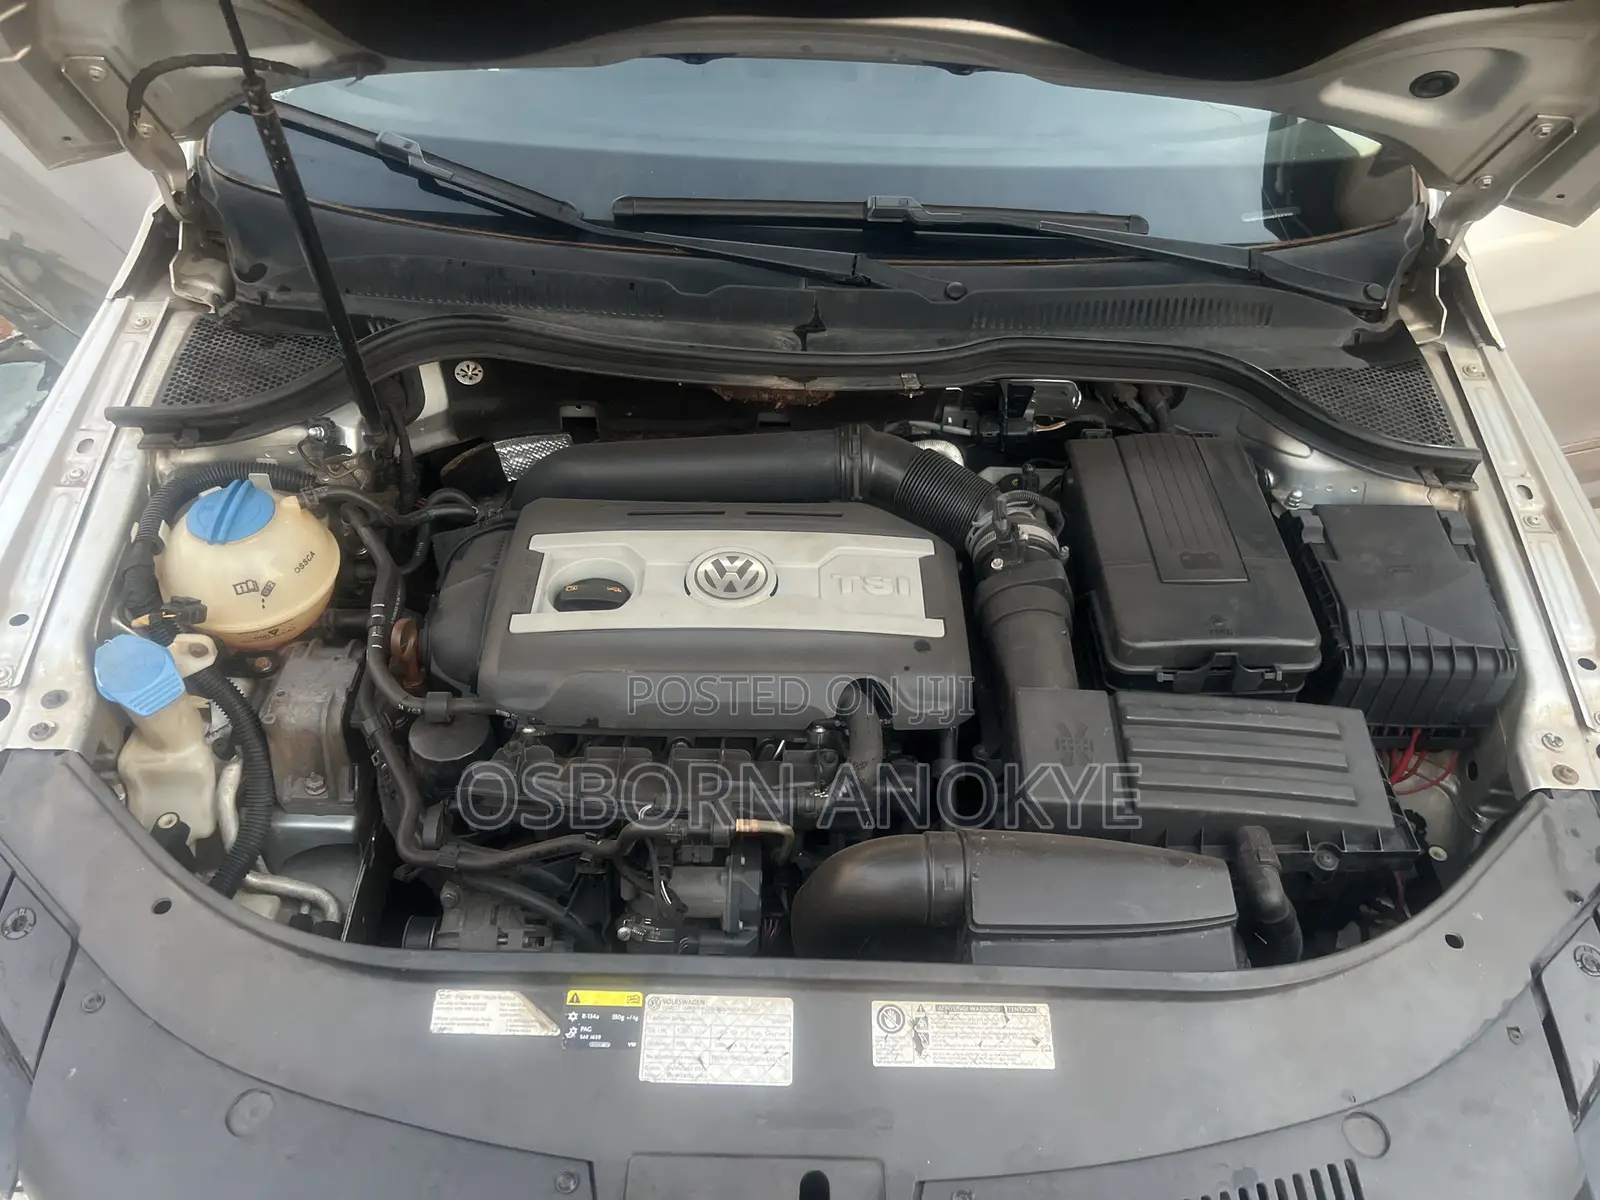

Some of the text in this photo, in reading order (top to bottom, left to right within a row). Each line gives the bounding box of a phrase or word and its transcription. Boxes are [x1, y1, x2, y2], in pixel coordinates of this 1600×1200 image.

[294, 551, 316, 574] OSSCA
[695, 551, 768, 600] VW
[830, 572, 911, 597] TSI
